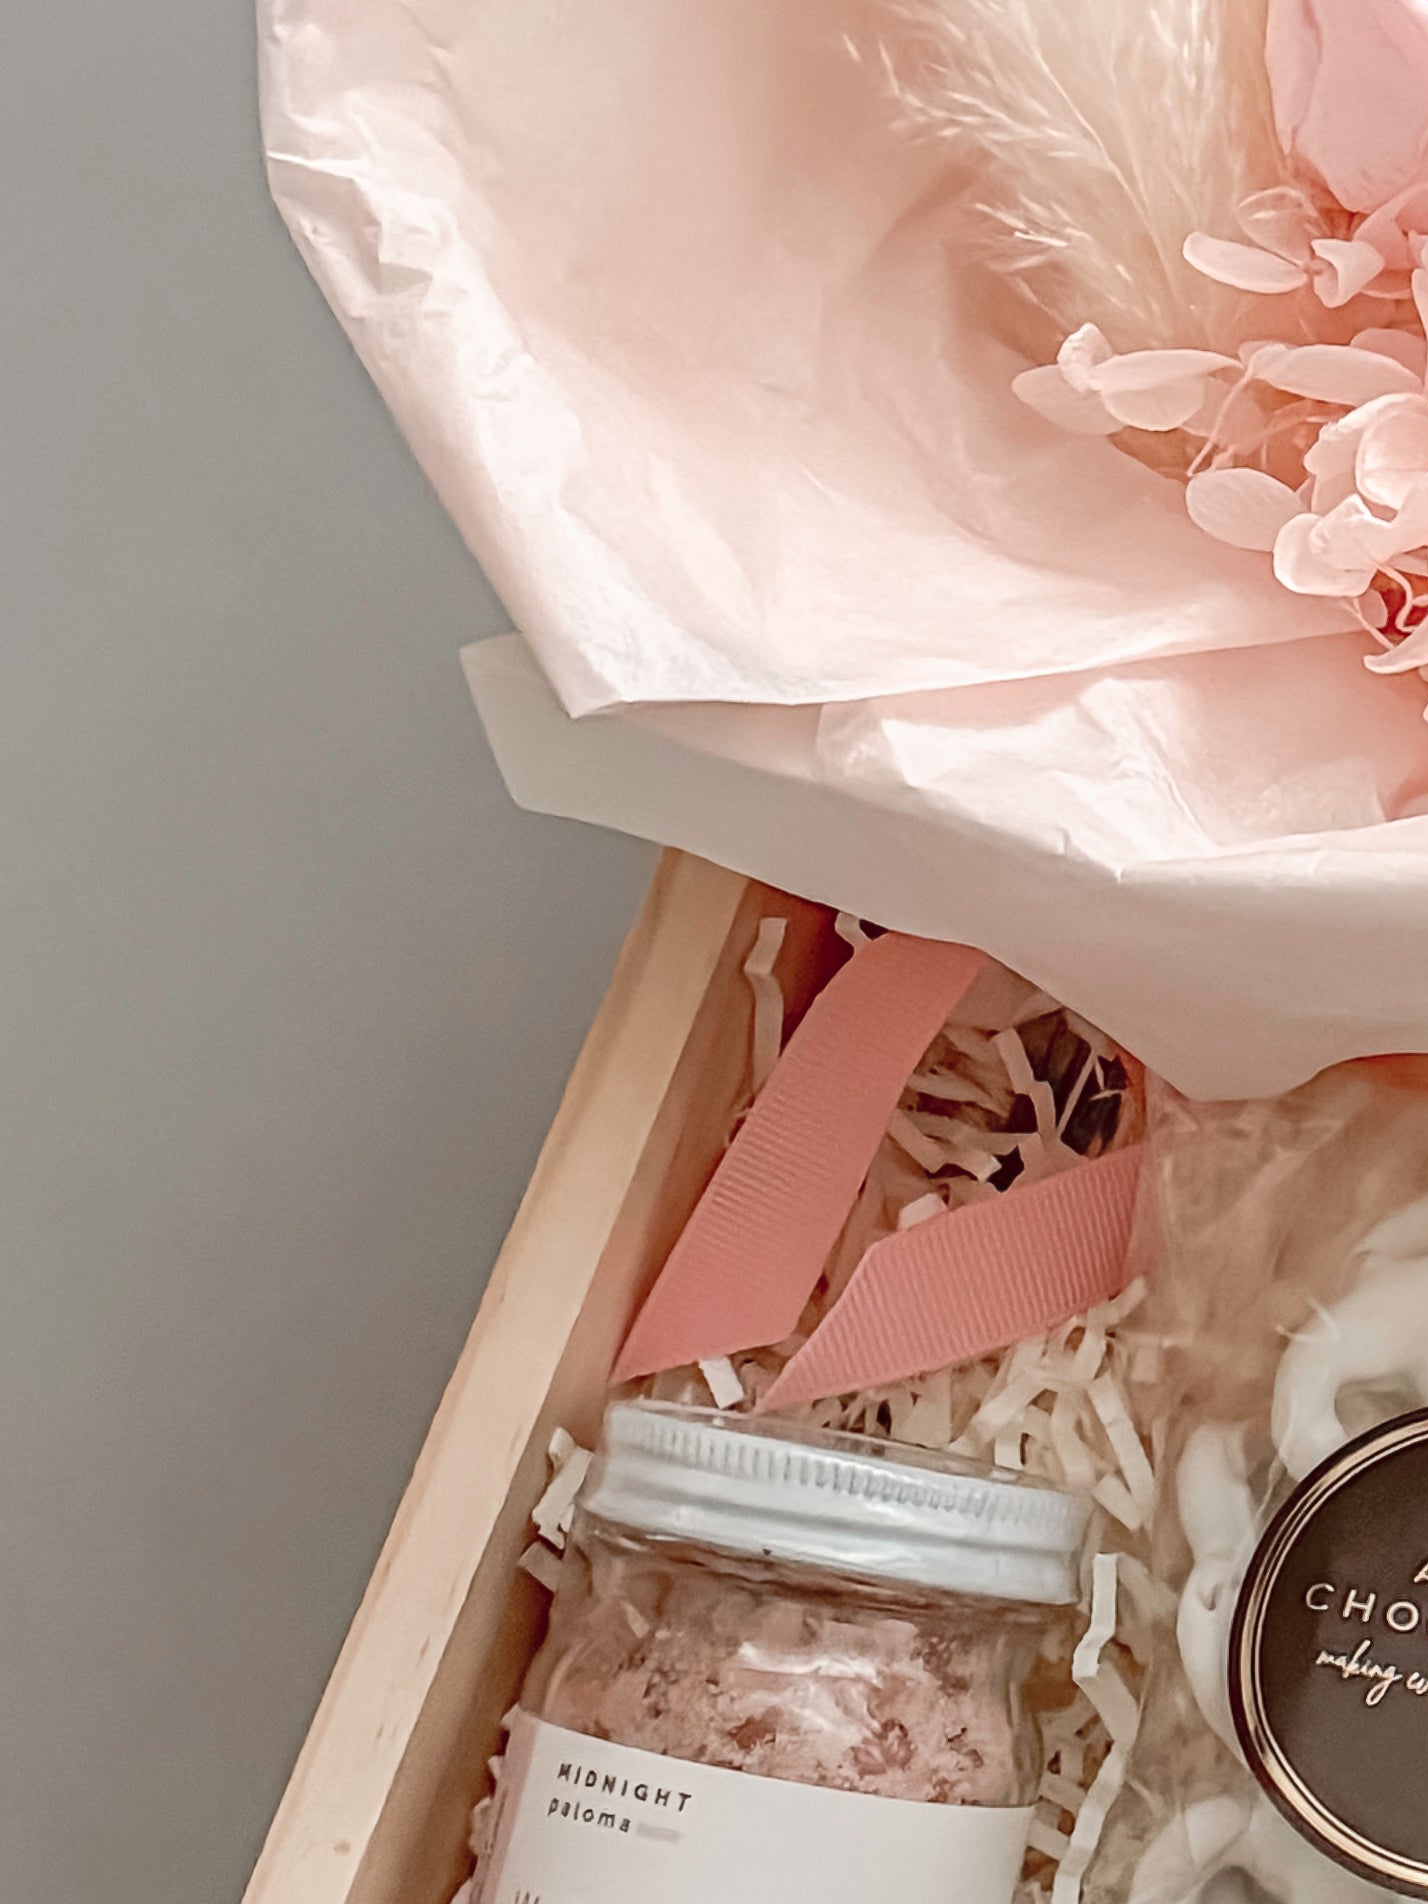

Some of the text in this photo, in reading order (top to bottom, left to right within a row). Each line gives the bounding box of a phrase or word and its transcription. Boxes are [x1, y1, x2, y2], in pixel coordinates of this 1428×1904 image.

[1315, 1639, 1403, 1707] making
[556, 1761, 693, 1813] MIDNIGHT
[546, 1796, 632, 1834] paloma
